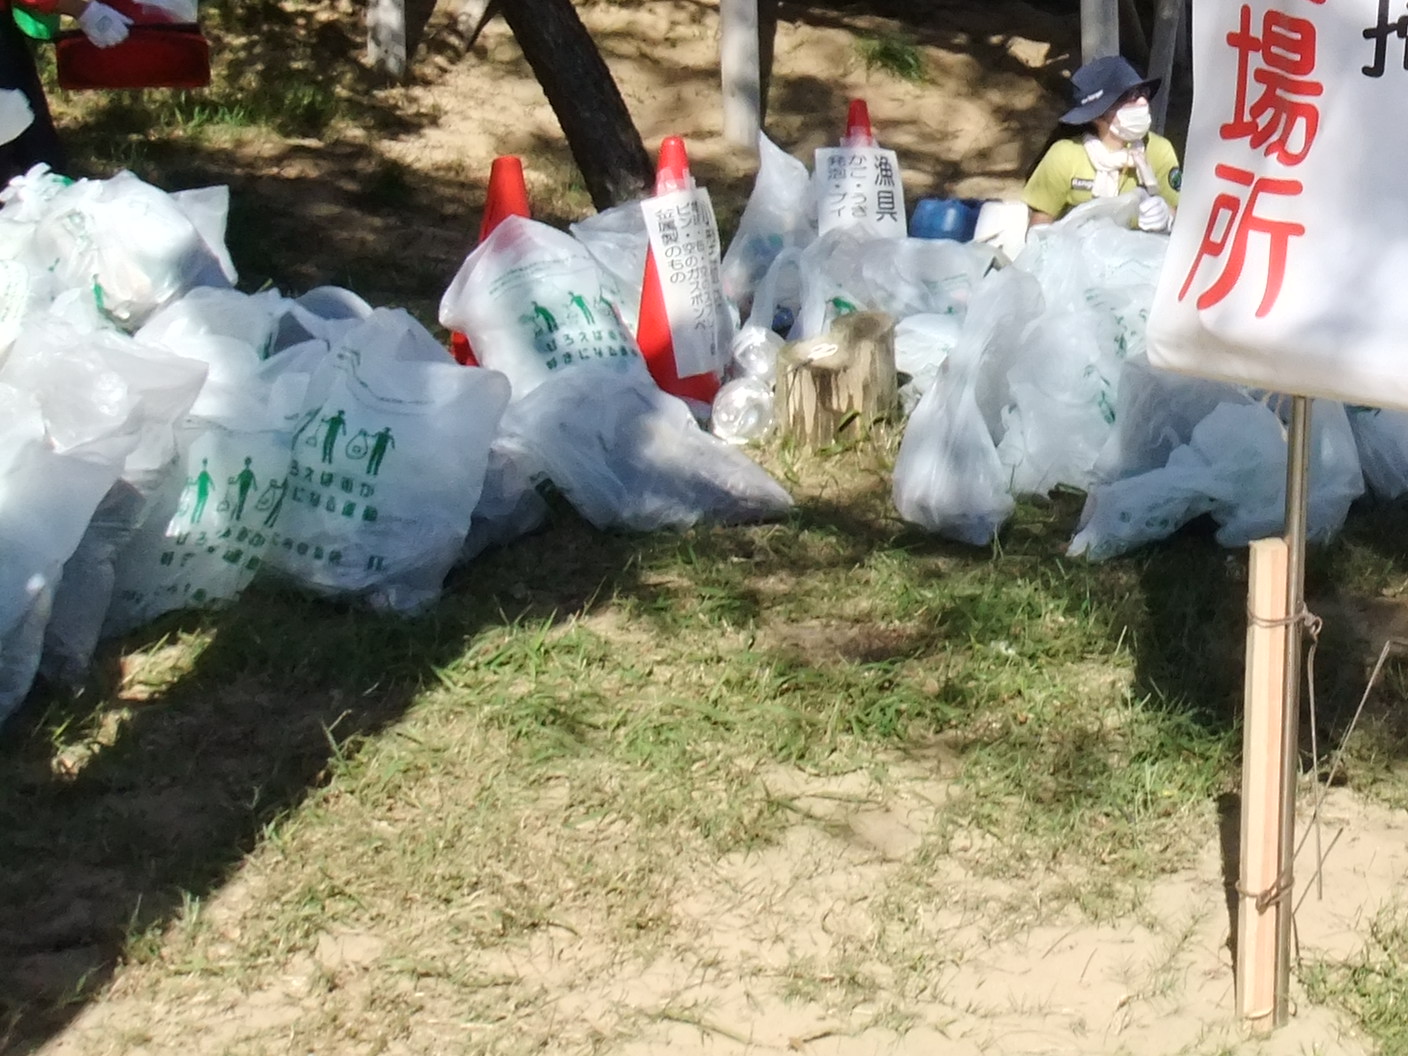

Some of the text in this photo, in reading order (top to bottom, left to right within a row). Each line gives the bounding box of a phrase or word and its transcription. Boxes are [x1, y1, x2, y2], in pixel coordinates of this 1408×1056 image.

[874, 154, 898, 223] 漁具
[655, 209, 687, 284] 金属製のもの
